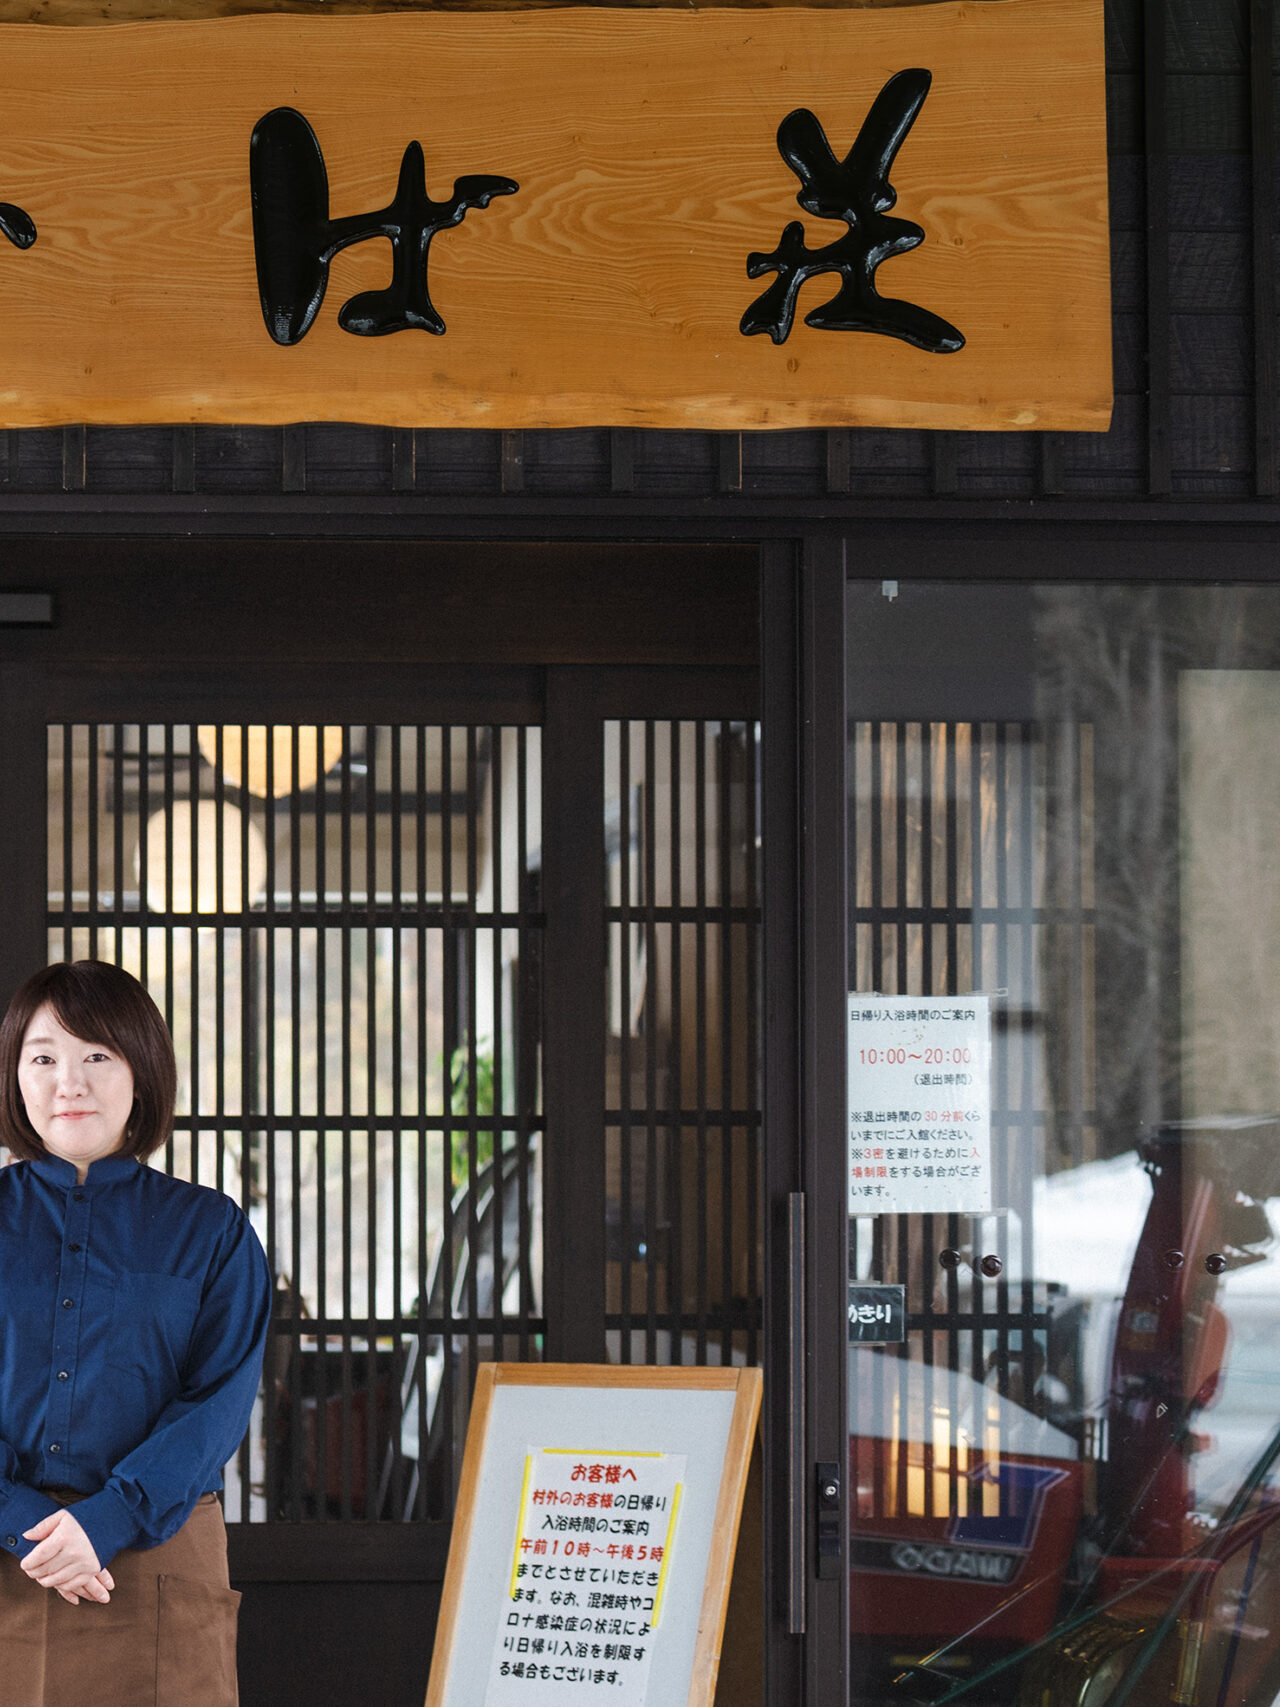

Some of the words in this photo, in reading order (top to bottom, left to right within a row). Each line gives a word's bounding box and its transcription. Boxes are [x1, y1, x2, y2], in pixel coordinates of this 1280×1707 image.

[850, 1009, 976, 1022] 日帰り入浴時間のご案内
[851, 1166, 982, 1178] 場制限をする場合がござ
[851, 1184, 890, 1197] います。
[570, 1463, 638, 1484] お客様へ
[532, 1489, 667, 1512] 村外のお客様の日帰り
[541, 1514, 650, 1537] 入浴時間のご案内
[516, 1563, 660, 1587] までとさせていただき
[506, 1612, 651, 1637] ロナ感染症の状況によ
[503, 1636, 647, 1662] り日帰り入浴を制限す
[499, 1661, 624, 1687] る場合もございます。
